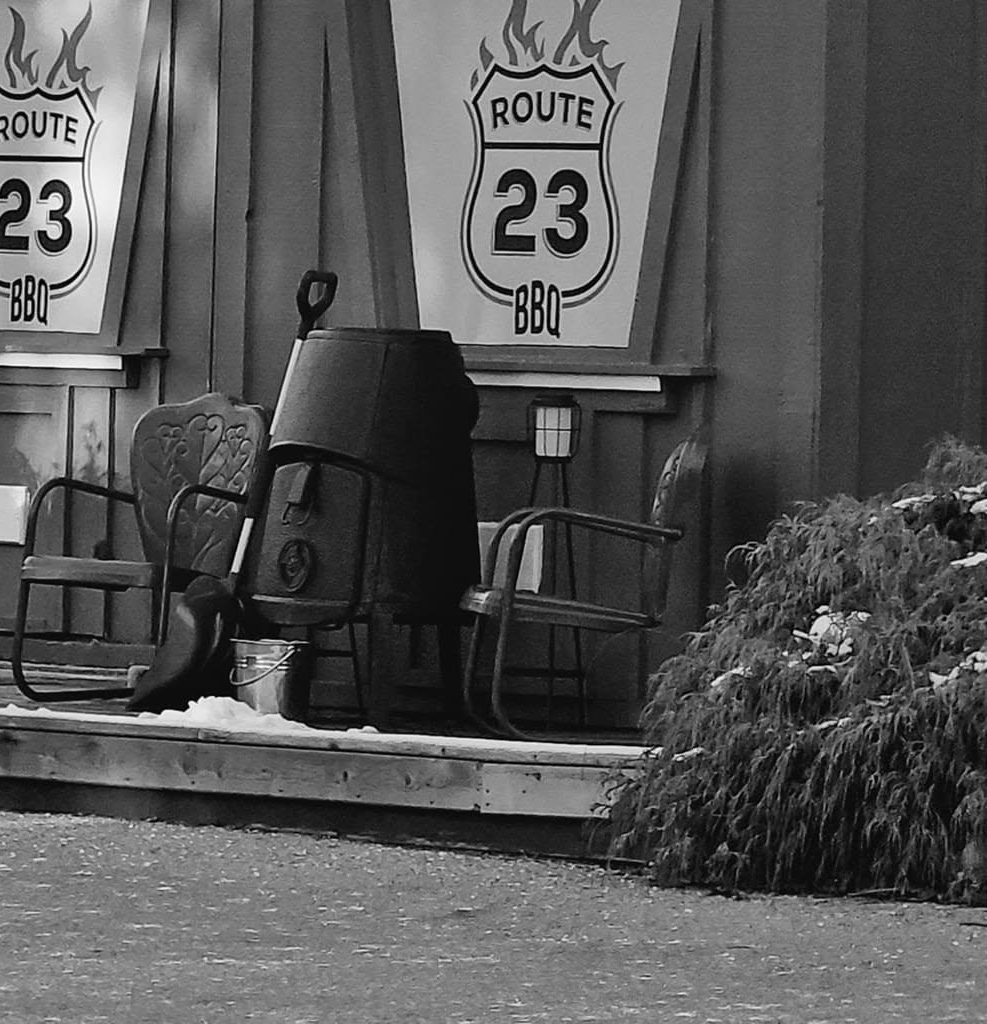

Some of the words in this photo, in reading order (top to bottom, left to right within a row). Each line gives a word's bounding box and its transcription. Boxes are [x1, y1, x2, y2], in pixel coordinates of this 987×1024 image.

[490, 91, 595, 130] ROUTE
[492, 168, 589, 259] 23
[10, 275, 48, 326] BBQ
[514, 280, 561, 339] BBQ
